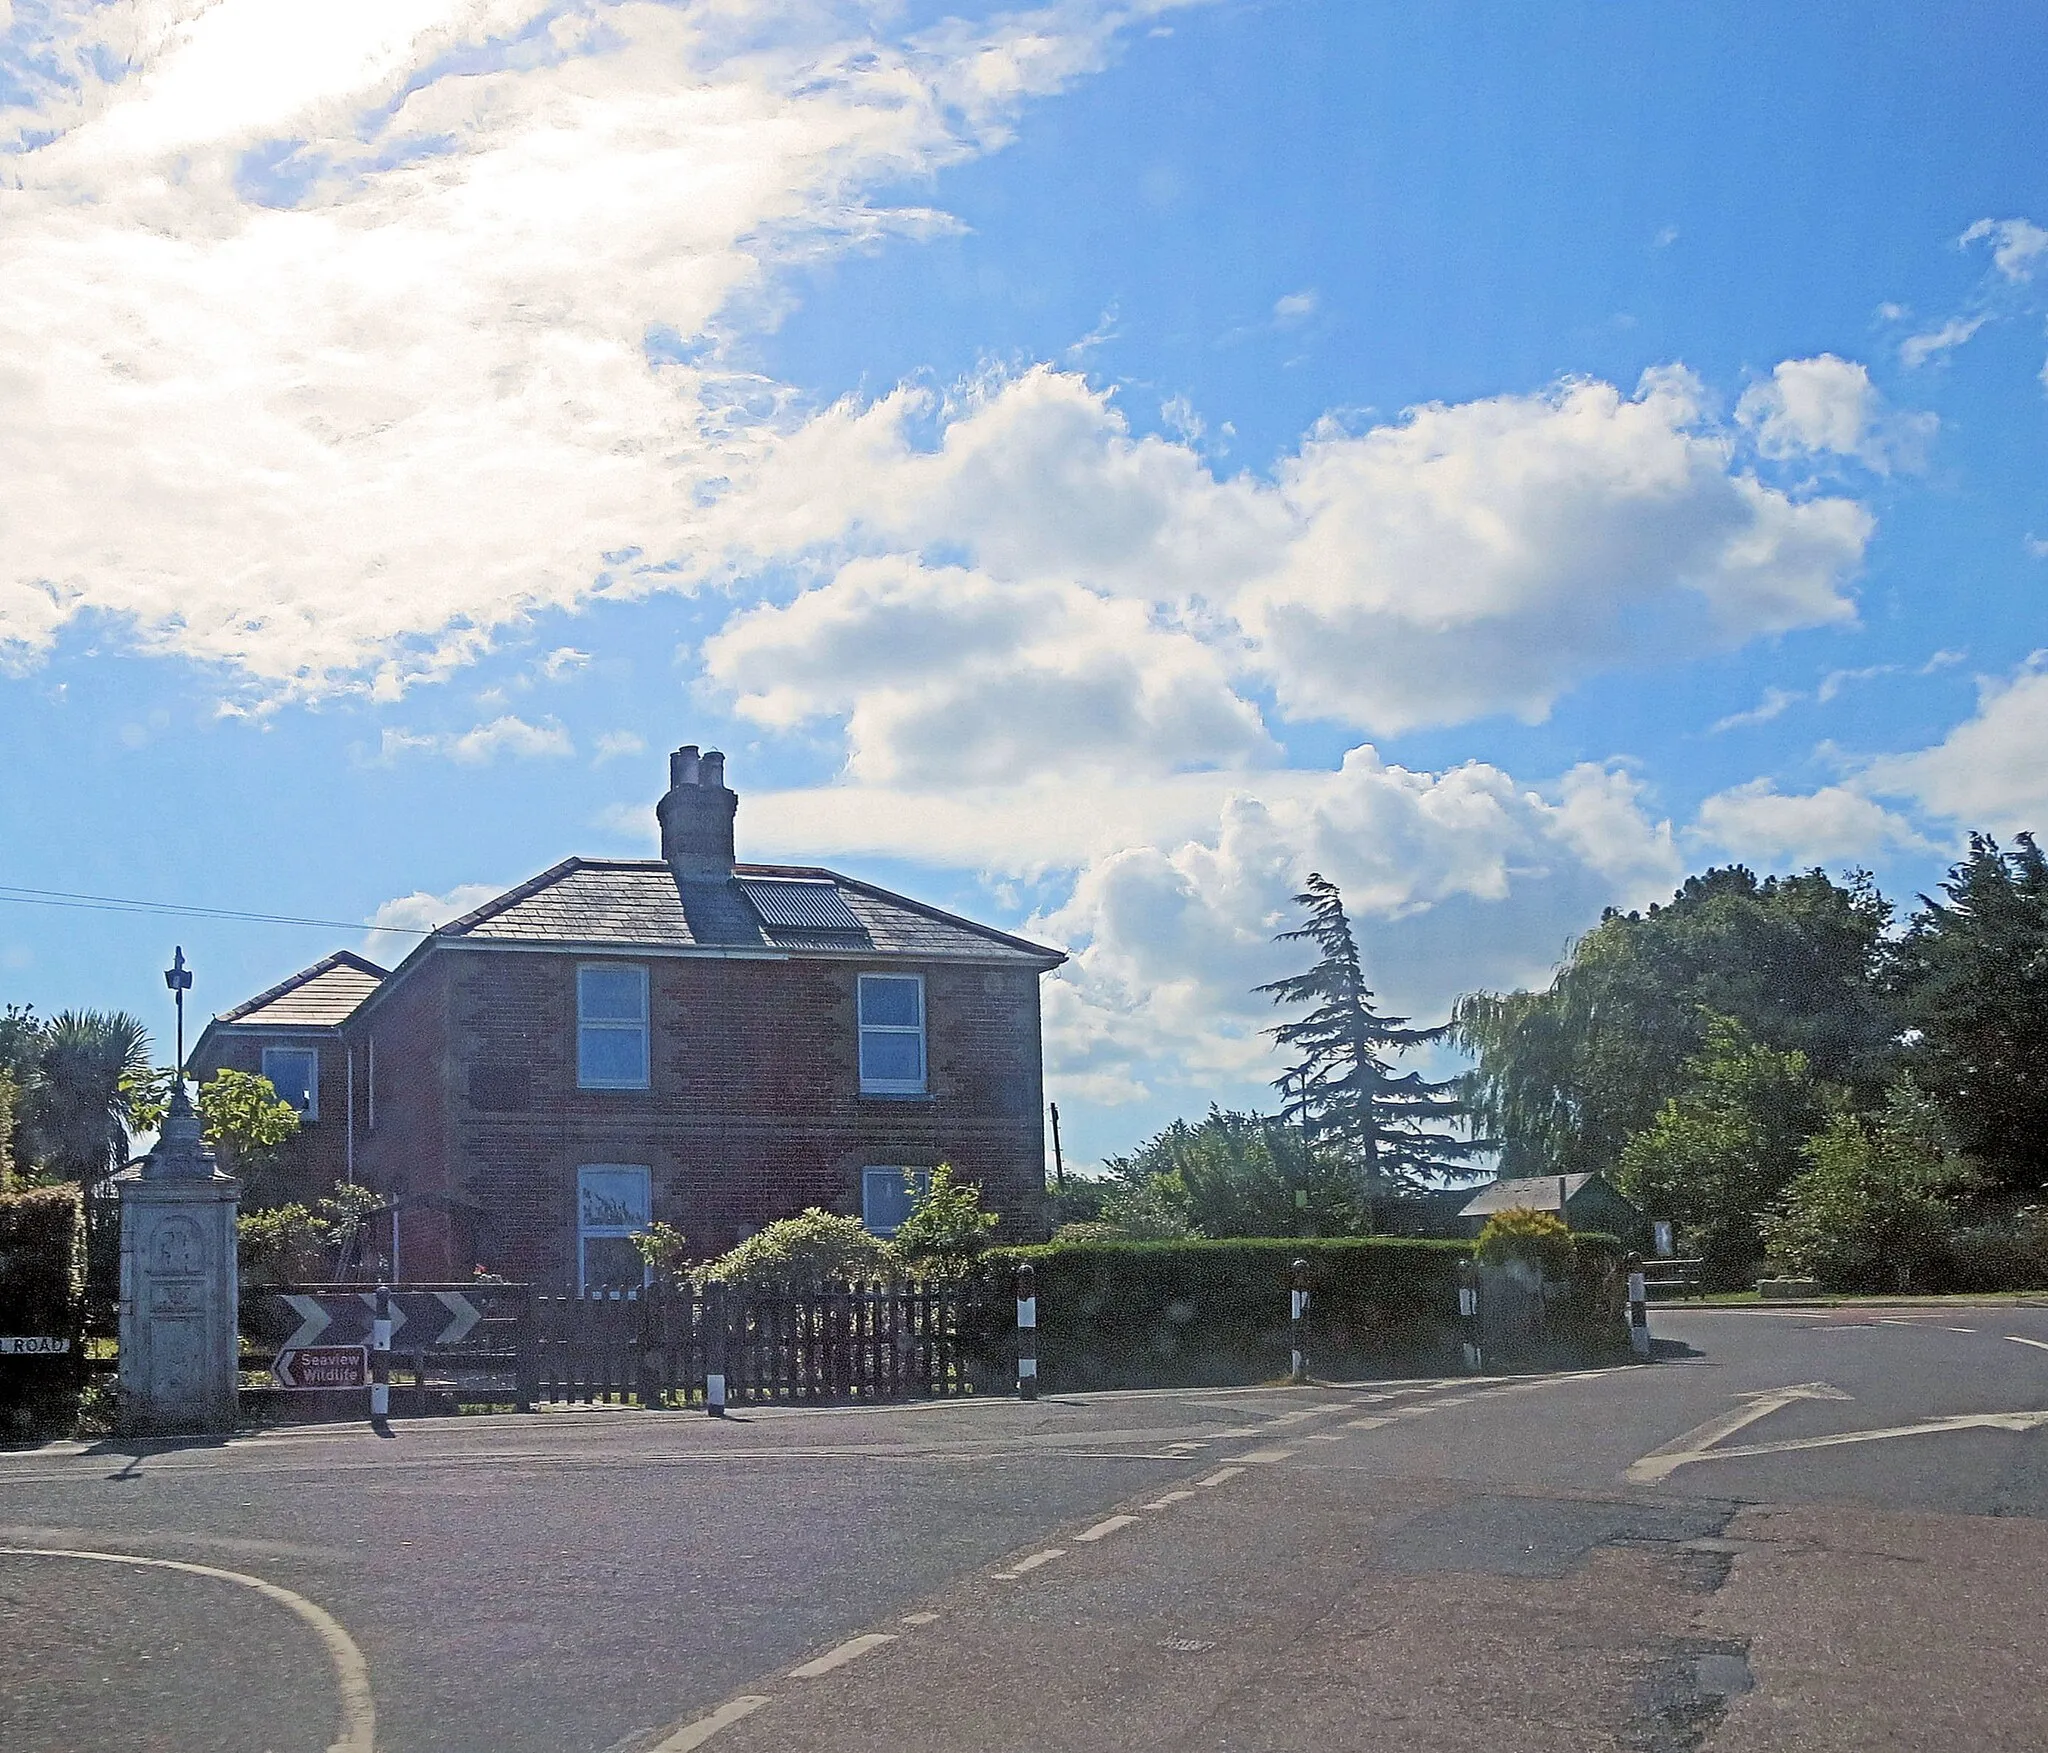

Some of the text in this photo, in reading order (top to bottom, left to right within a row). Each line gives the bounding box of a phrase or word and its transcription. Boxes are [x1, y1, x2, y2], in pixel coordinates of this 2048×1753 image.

[14, 1339, 63, 1351] ROAD
[301, 1353, 360, 1366] Seaview
[303, 1368, 358, 1381] Wildlife
